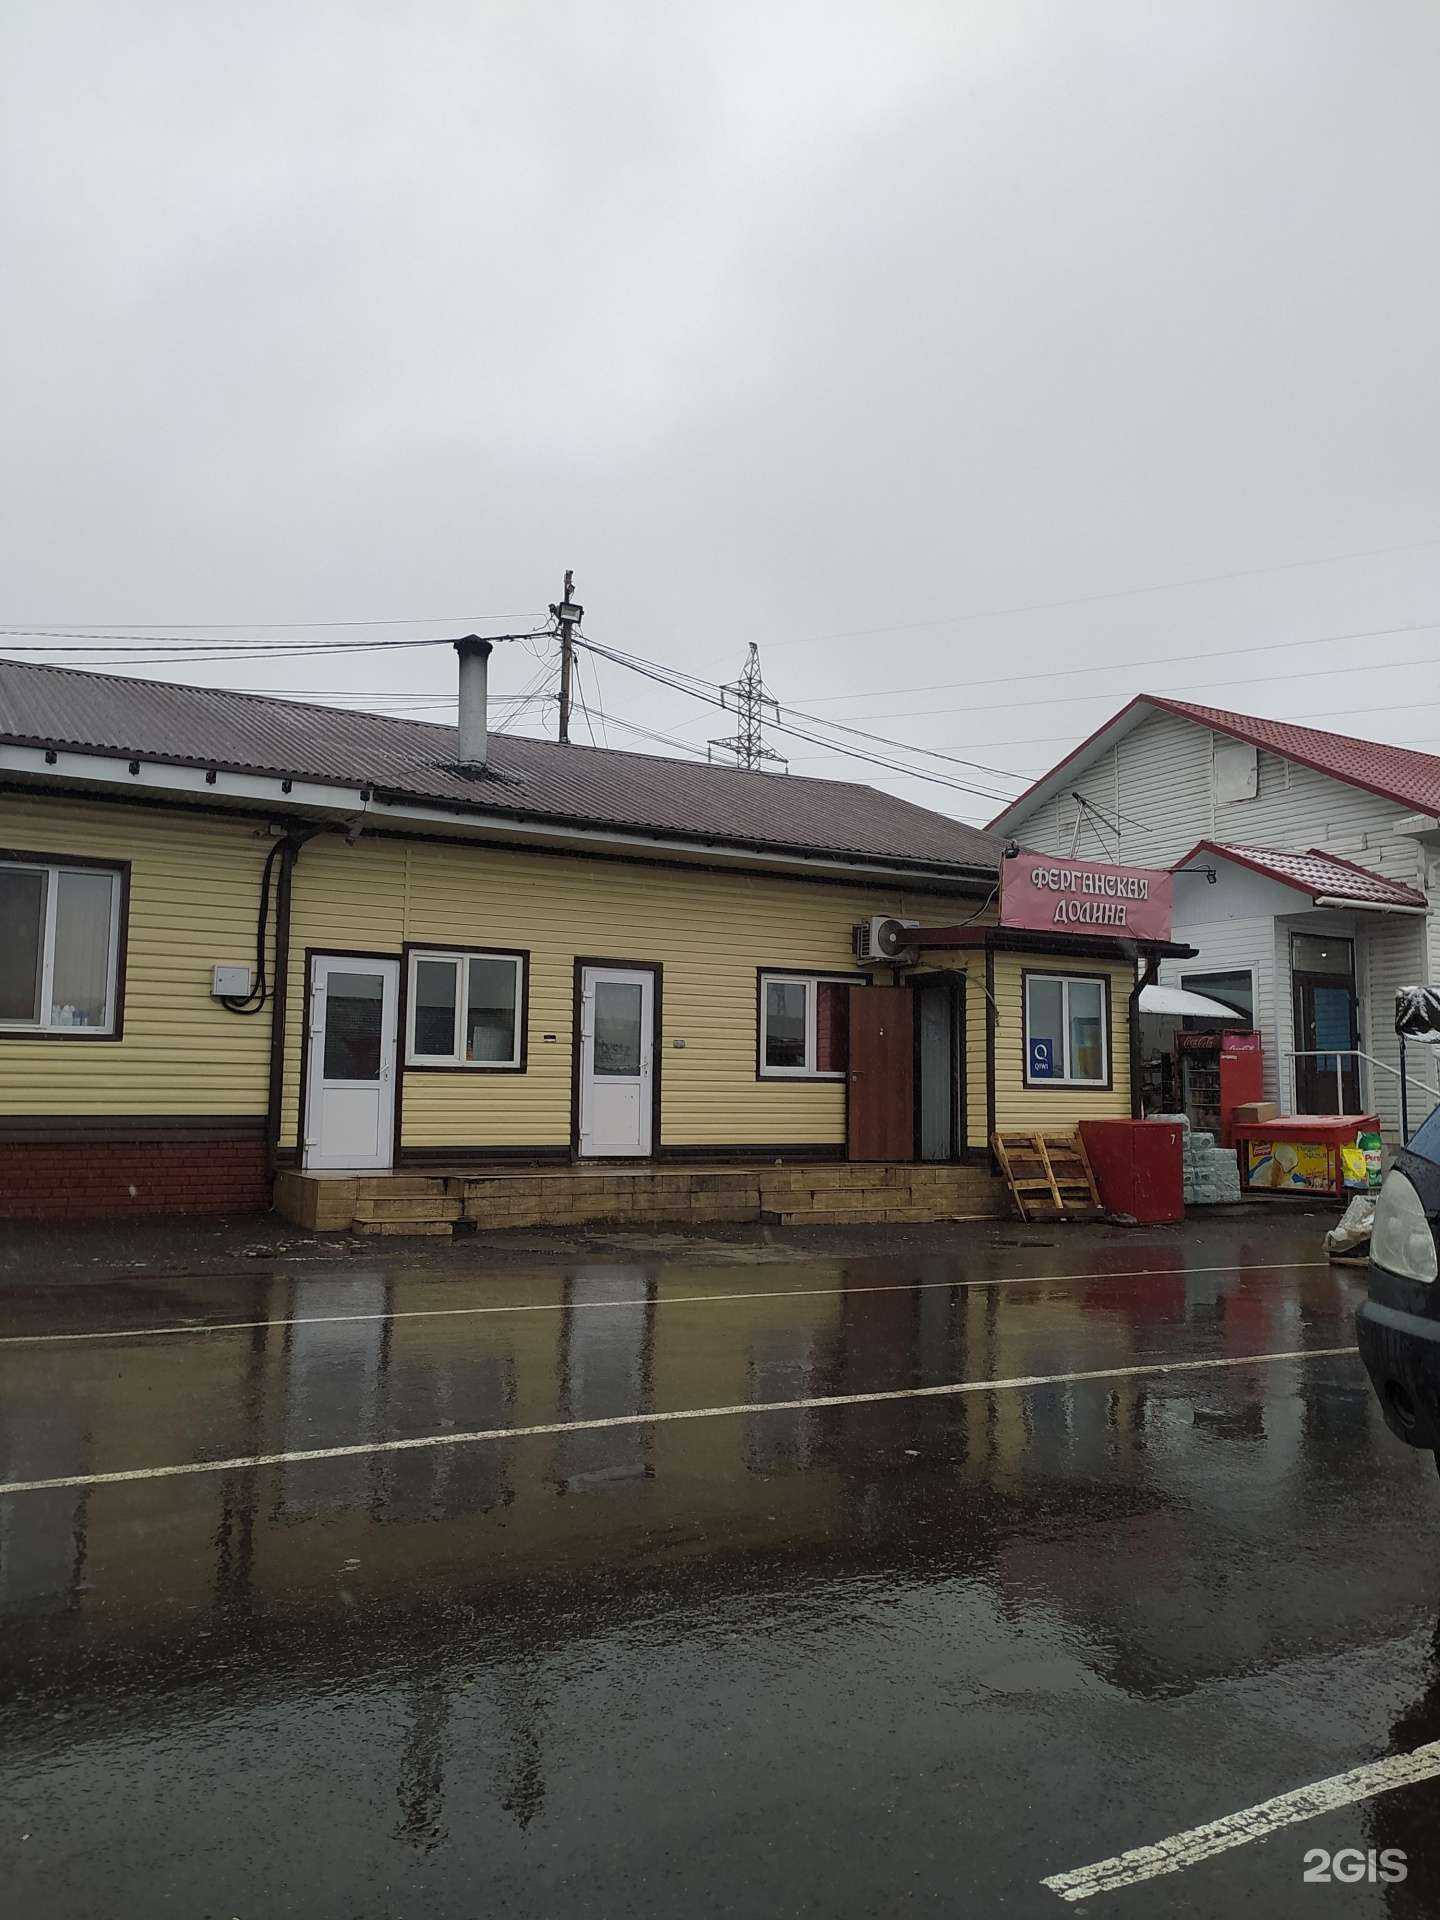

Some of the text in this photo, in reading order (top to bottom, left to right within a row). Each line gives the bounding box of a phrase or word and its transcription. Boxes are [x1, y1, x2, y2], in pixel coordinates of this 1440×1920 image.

[1031, 867, 1149, 900] ФЕРГАНСКАЯ
[1054, 899, 1127, 926] ДОЛИНА
[1170, 1134, 1176, 1145] 7
